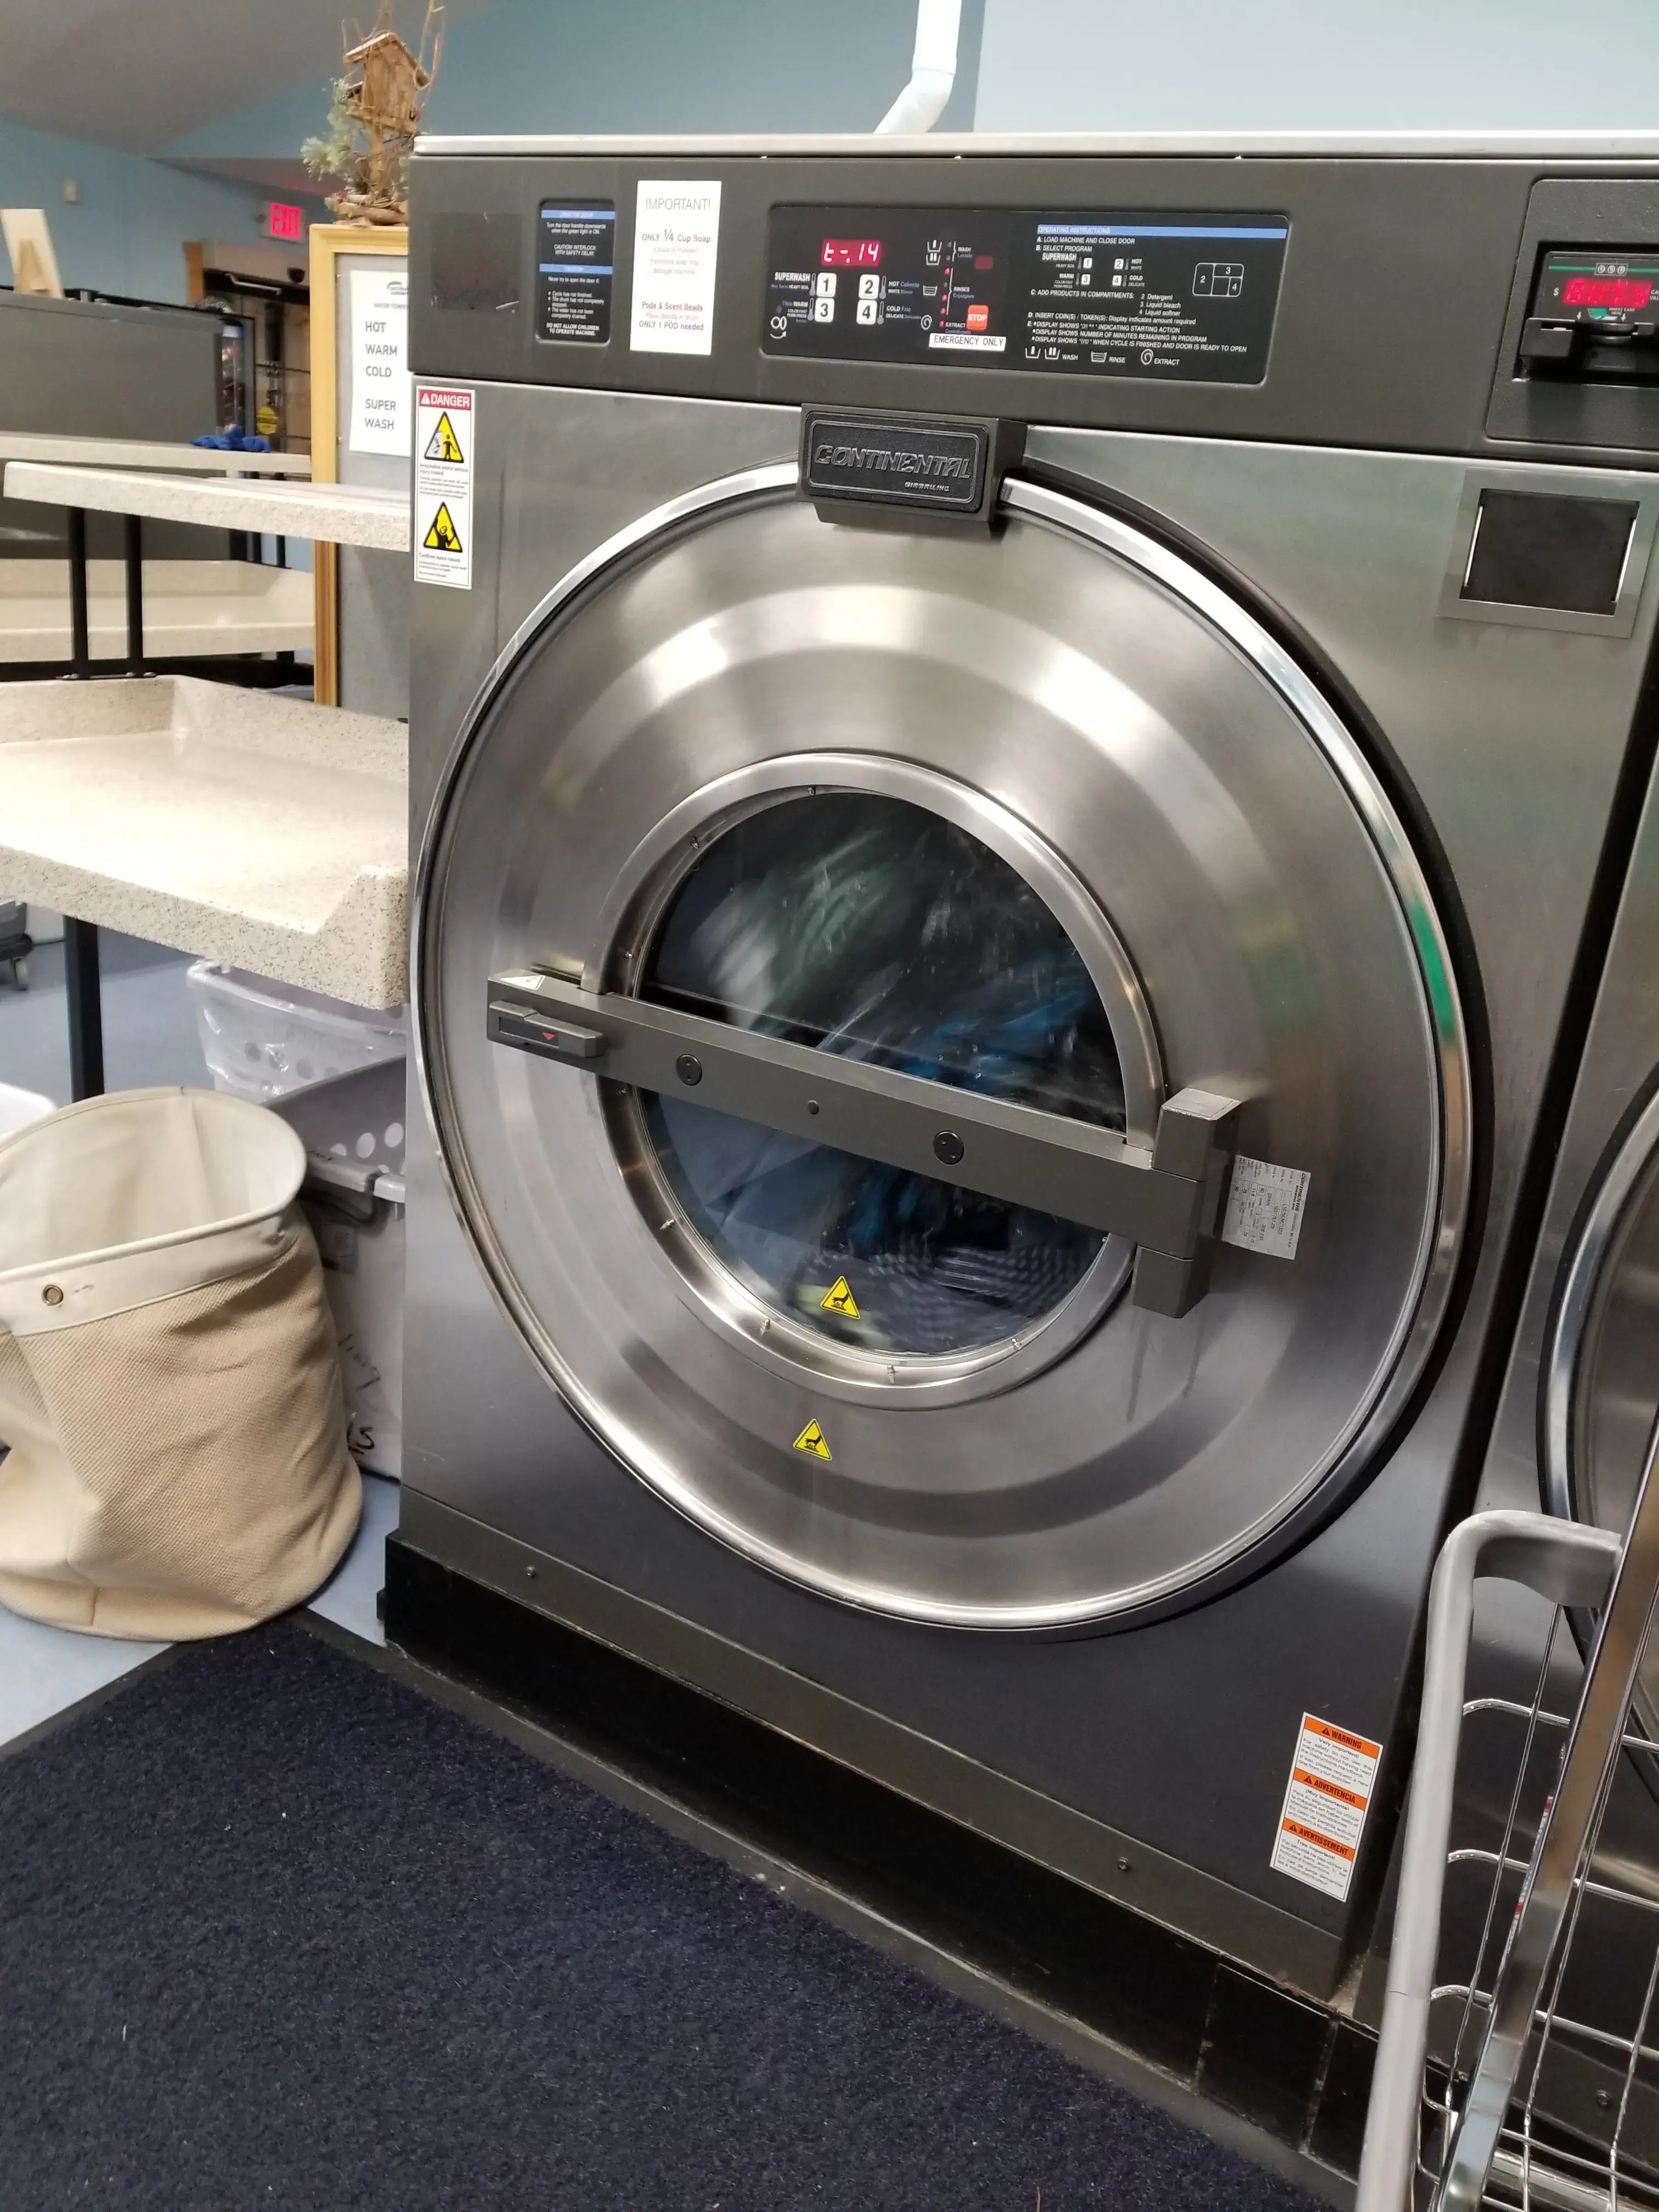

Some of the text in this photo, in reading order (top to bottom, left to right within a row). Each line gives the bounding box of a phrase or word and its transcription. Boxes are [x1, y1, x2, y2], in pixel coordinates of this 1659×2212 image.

[646, 198, 710, 210] IMPORTANT!
[272, 203, 301, 237] EXIT
[678, 234, 691, 243] Cup
[693, 235, 710, 244] Soap
[775, 272, 811, 281] SUPERWASH
[823, 278, 828, 292] 1
[864, 280, 873, 294] 2
[1553, 287, 1559, 296] $
[820, 303, 828, 317] 3
[862, 305, 871, 319] 4
[968, 313, 987, 321] STOP
[365, 321, 386, 332] HOT
[934, 335, 1004, 347] EMERGENCY ONLY
[365, 343, 397, 356] WARM
[365, 365, 392, 377] COLD
[365, 398, 396, 411] SUPER
[431, 393, 470, 408] DANGER
[365, 417, 394, 430] WASH
[814, 444, 972, 479] CONTINENTAL
[1332, 1730, 1362, 1749] WARNING
[1319, 1737, 1359, 1758] Very important!
[1314, 1780, 1355, 1804] ADVERTENCIA
[1319, 1794, 1349, 1810] importante!
[1299, 1828, 1348, 1855] AVERTISSEMENT
